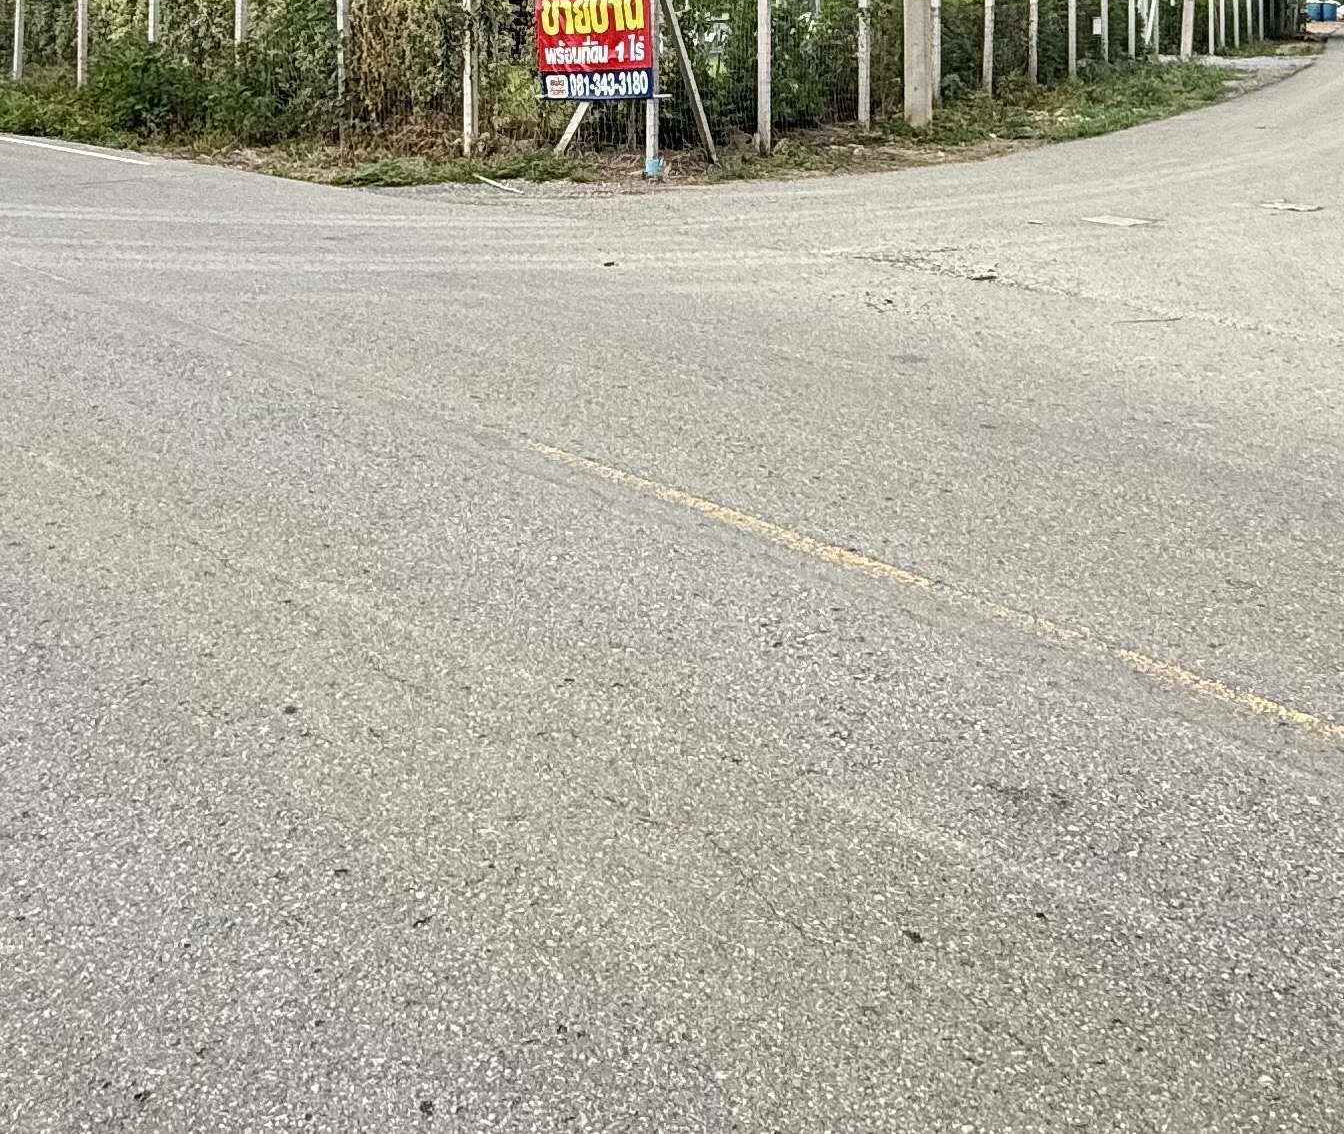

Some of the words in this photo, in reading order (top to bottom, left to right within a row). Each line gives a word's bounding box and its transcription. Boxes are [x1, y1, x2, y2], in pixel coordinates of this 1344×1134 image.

[544, 36, 609, 64] พร้อมที่ดิน
[616, 41, 625, 62] 1
[628, 34, 645, 61] ไร่
[570, 70, 649, 97] 081-343-3180
